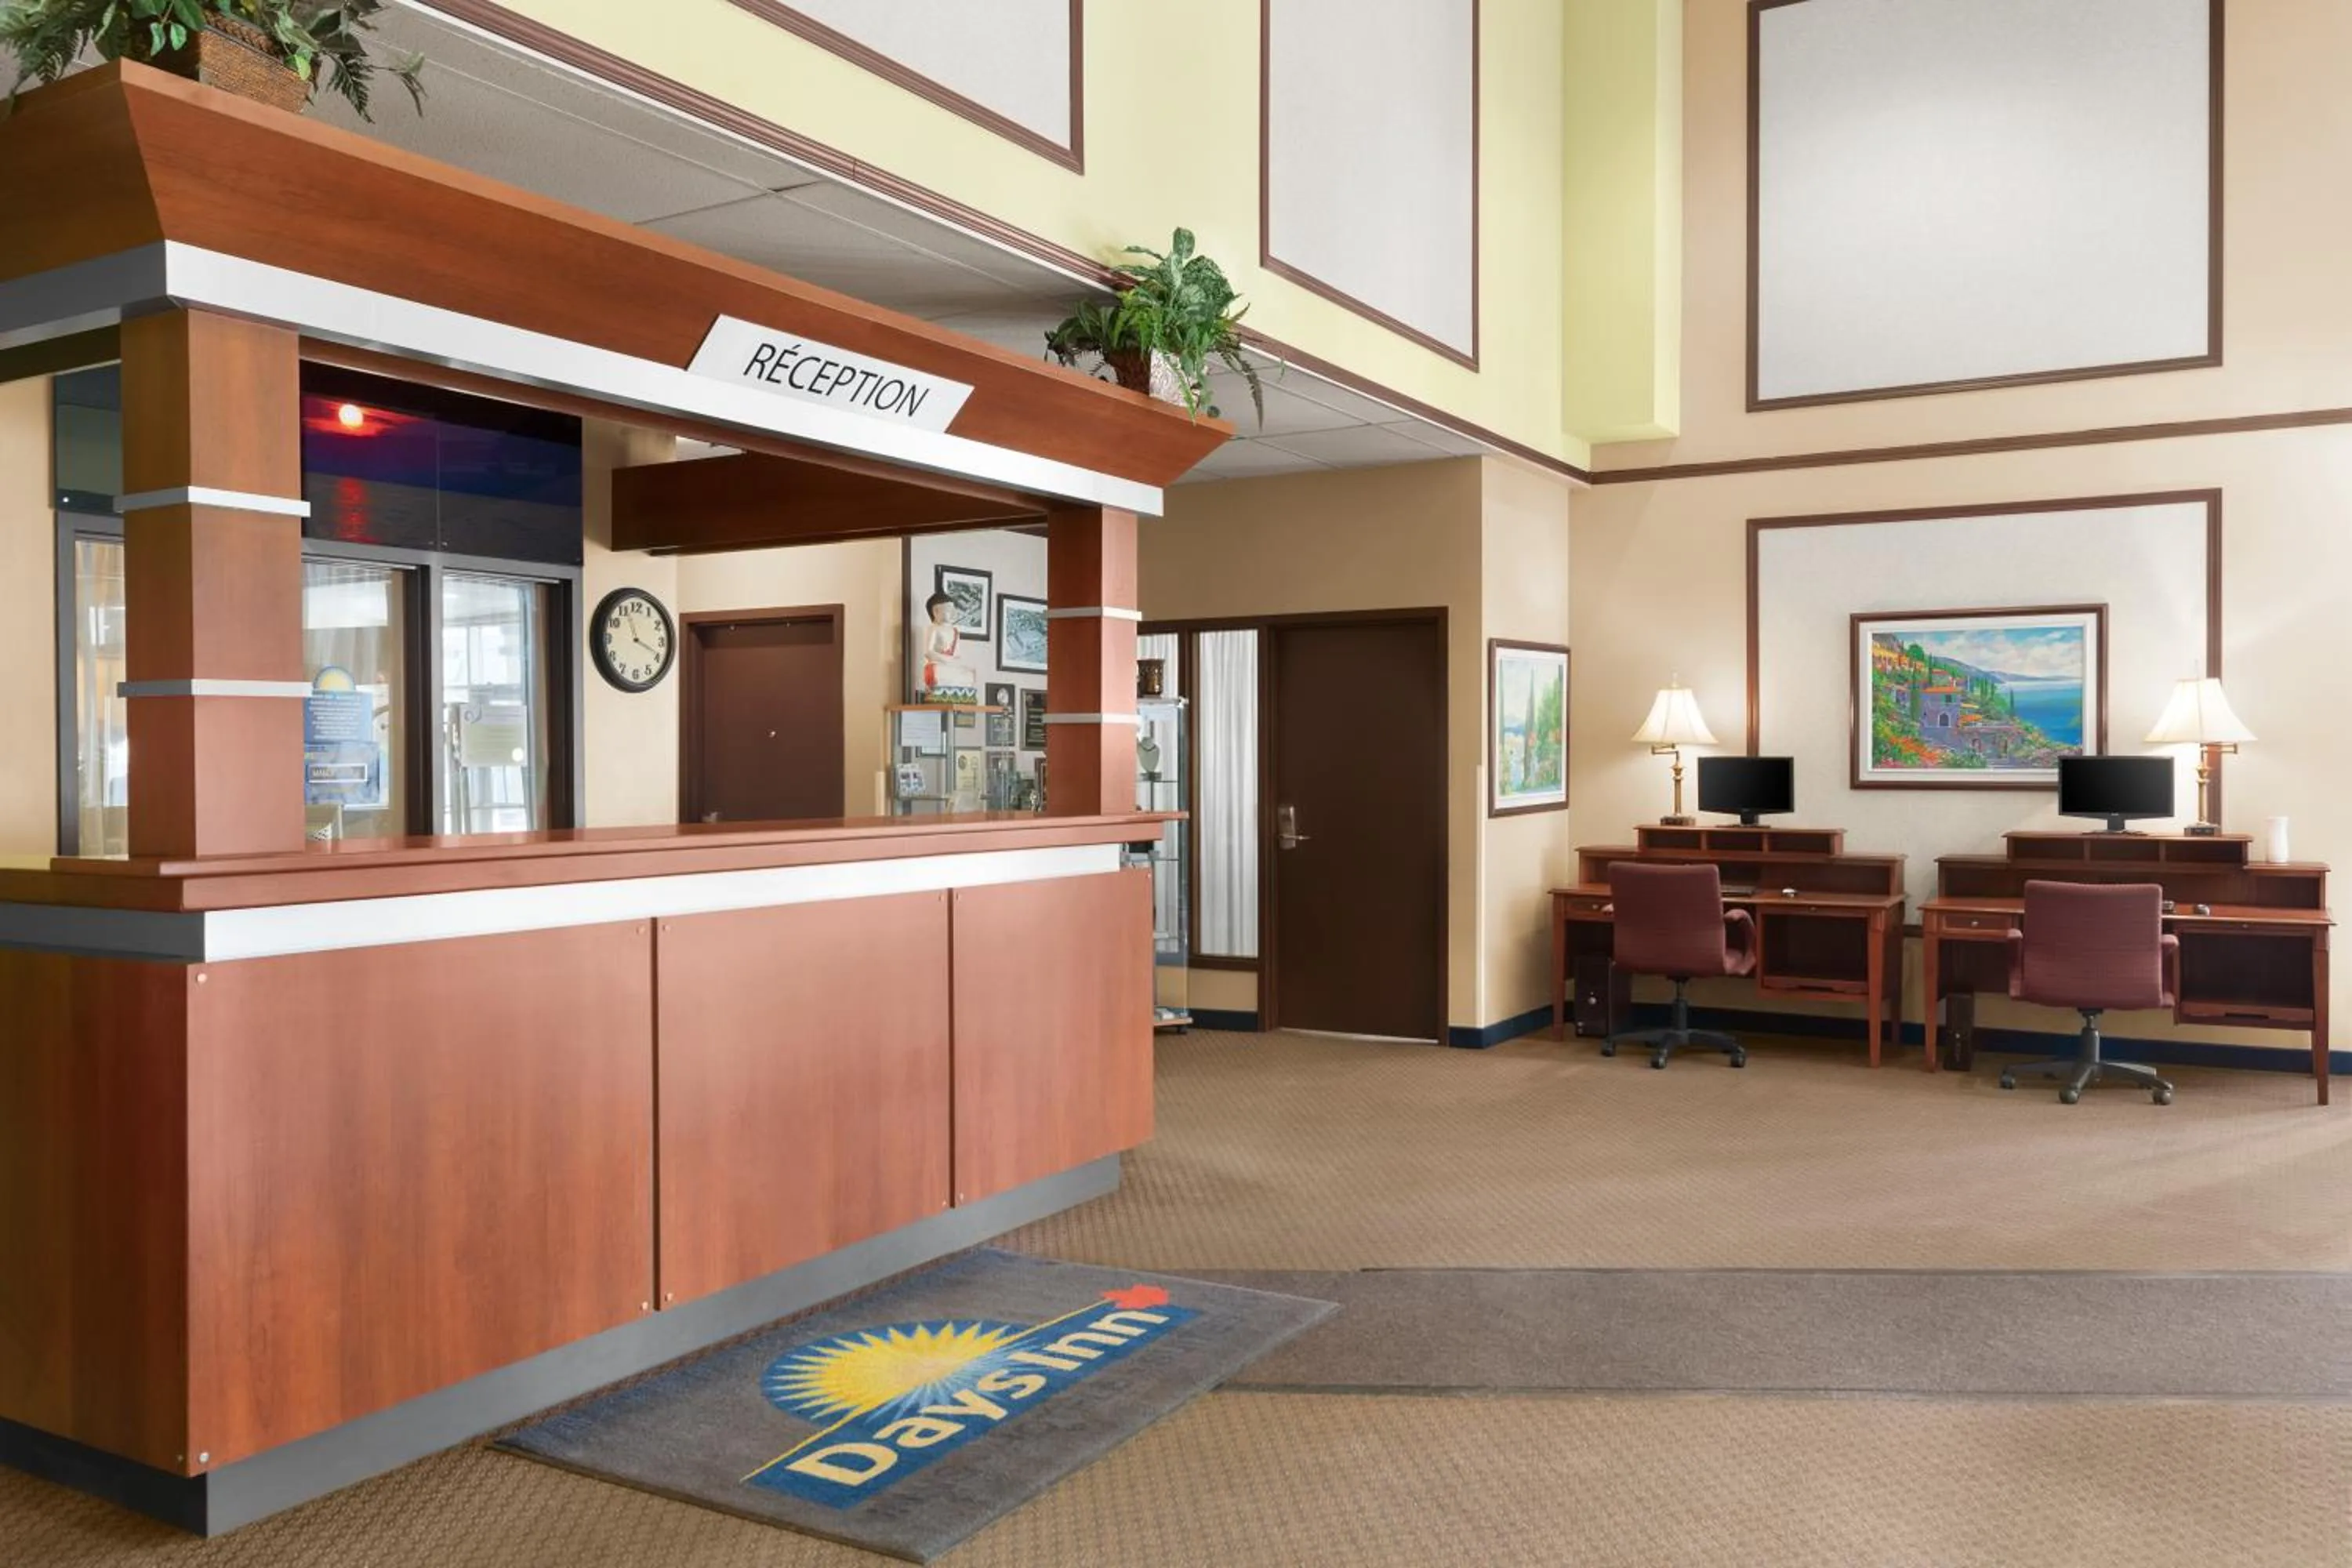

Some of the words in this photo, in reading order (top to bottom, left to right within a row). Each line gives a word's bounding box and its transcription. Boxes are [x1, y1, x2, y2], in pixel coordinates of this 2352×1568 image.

[742, 343, 929, 417] RÉCEPTION
[619, 606, 628, 616] 11
[630, 602, 642, 614] 12
[646, 607, 651, 617] 1
[609, 618, 620, 628] 10
[655, 620, 661, 630] 2
[605, 633, 612, 644] 9
[659, 637, 665, 648] 3
[610, 651, 616, 661] 8
[653, 652, 660, 663] 4
[619, 663, 626, 673] 7
[644, 664, 652, 675] 5
[632, 669, 639, 680] 6
[785, 1369, 1047, 1486] Days
[1011, 1310, 1170, 1371] Inn
